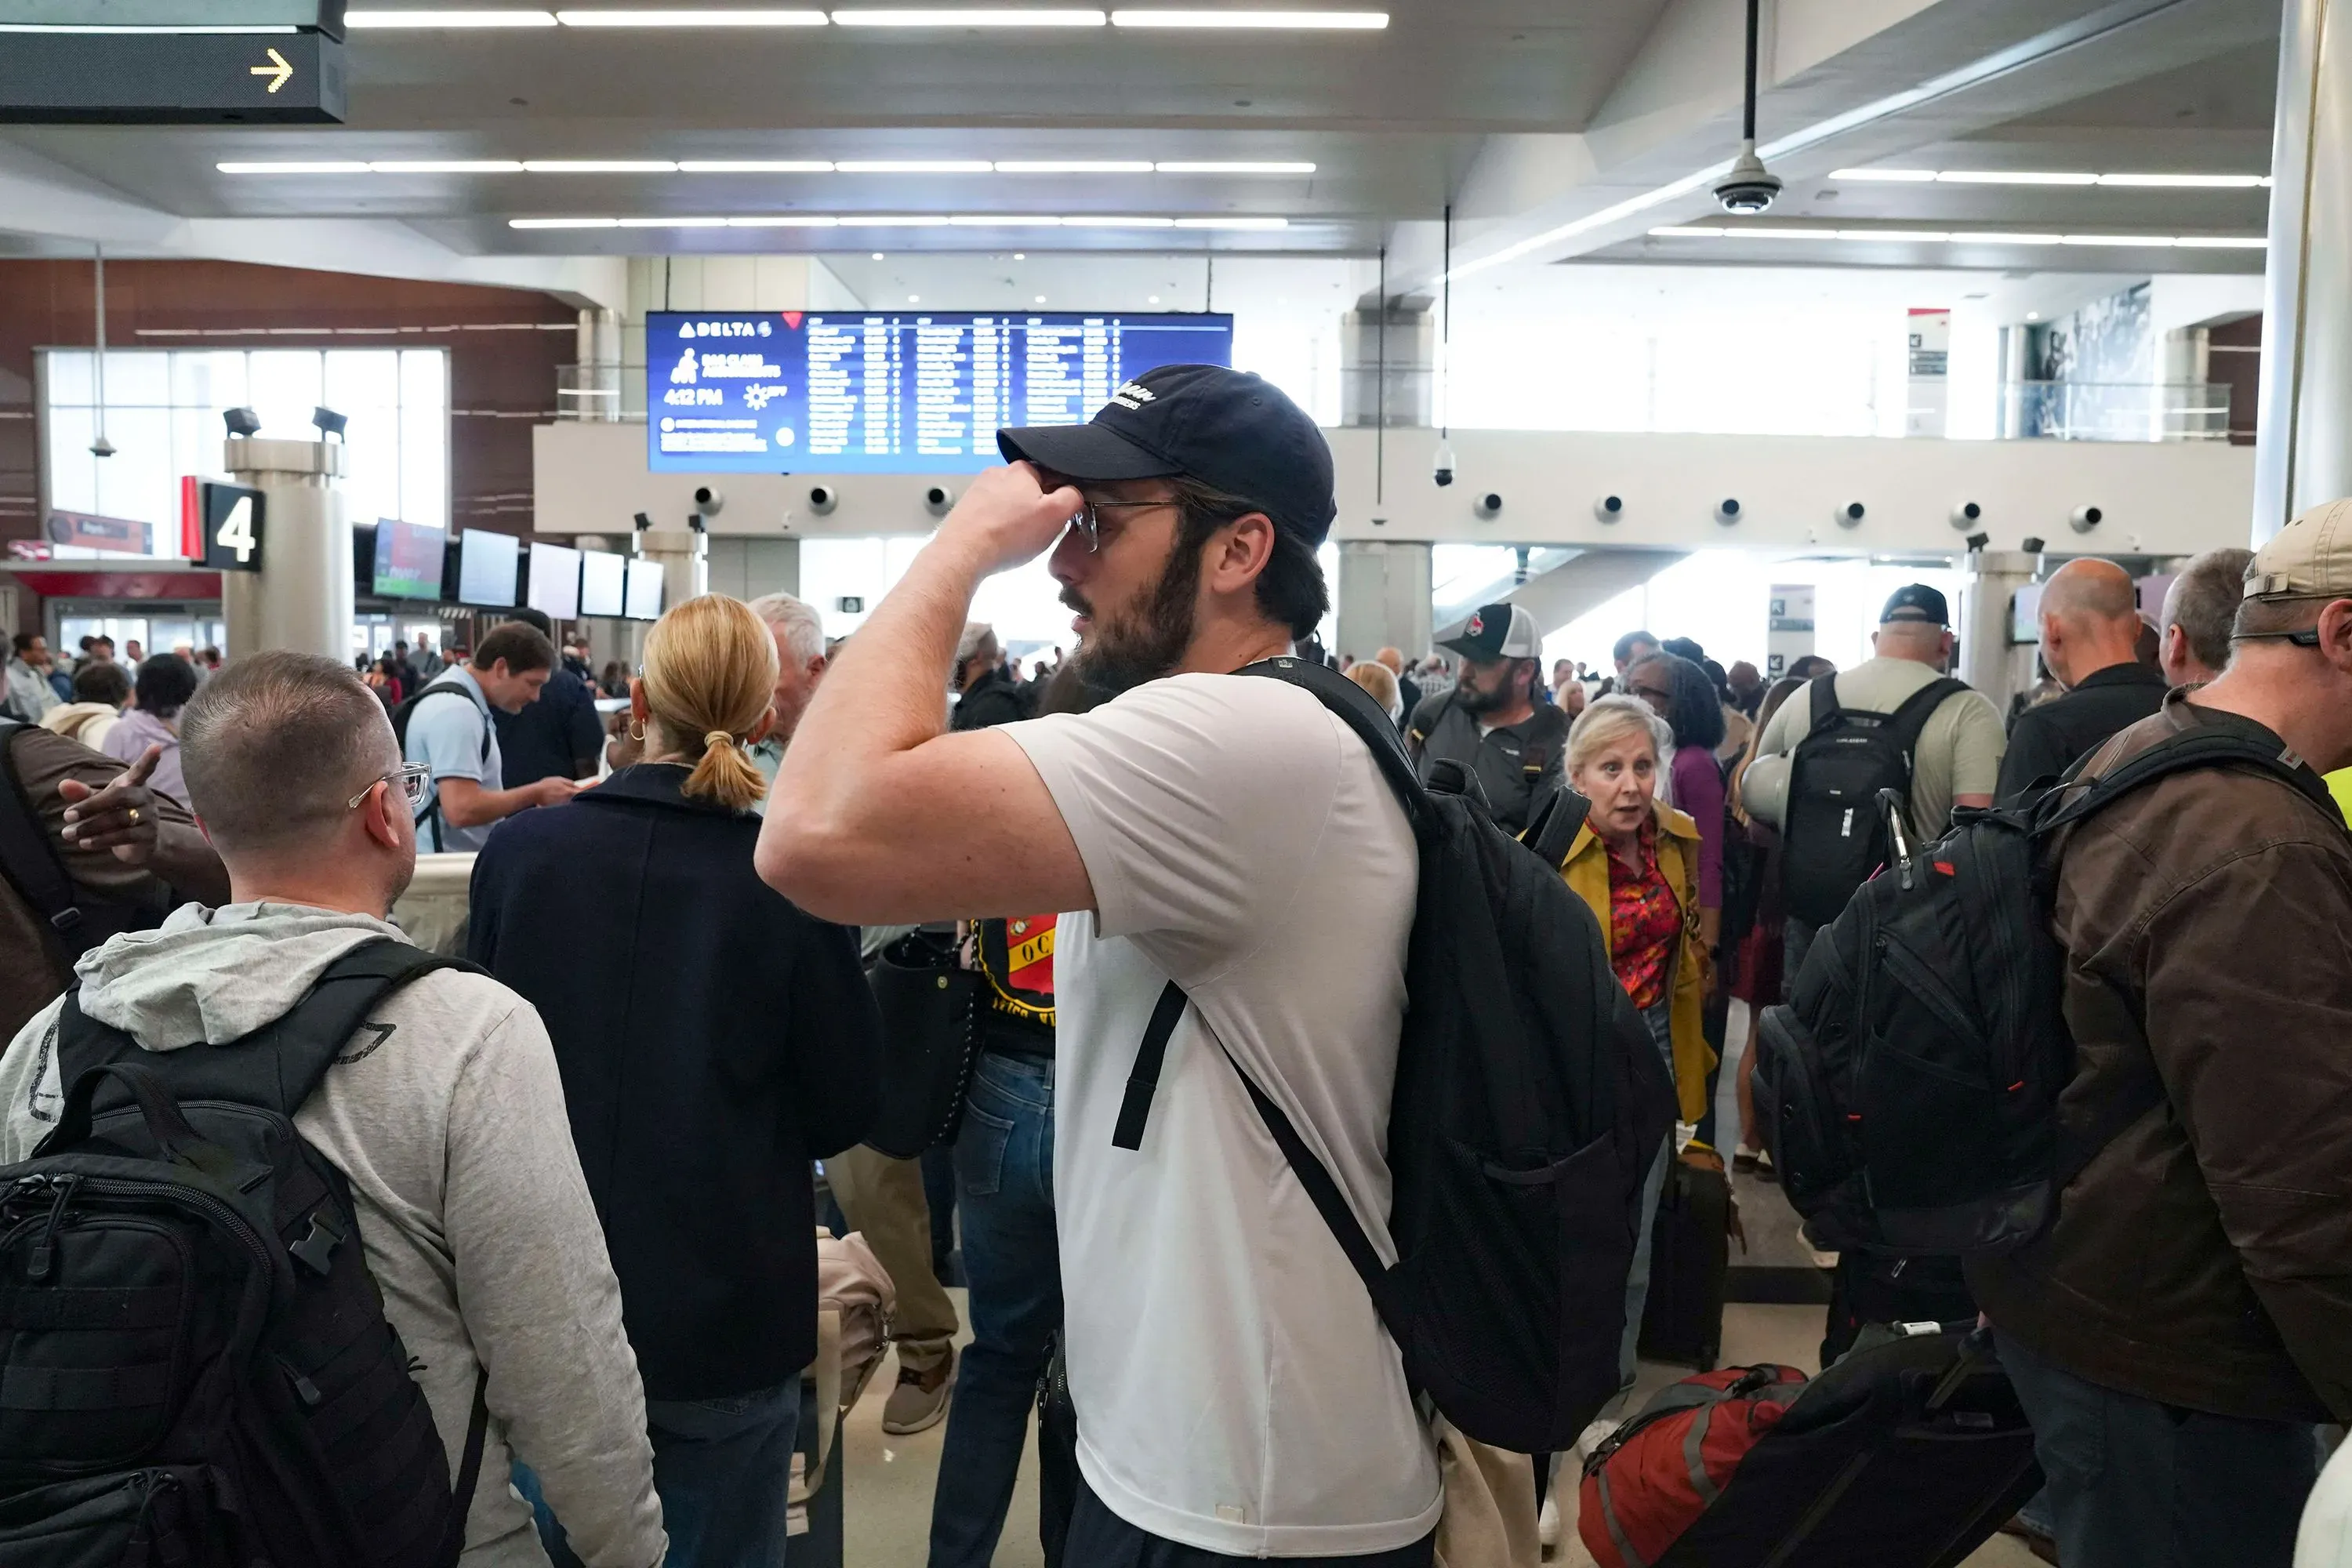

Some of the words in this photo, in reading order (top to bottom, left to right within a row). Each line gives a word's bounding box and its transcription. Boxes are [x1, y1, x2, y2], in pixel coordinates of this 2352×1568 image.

[696, 322, 755, 337] DELTA
[696, 388, 723, 405] PM
[216, 495, 256, 563] 4
